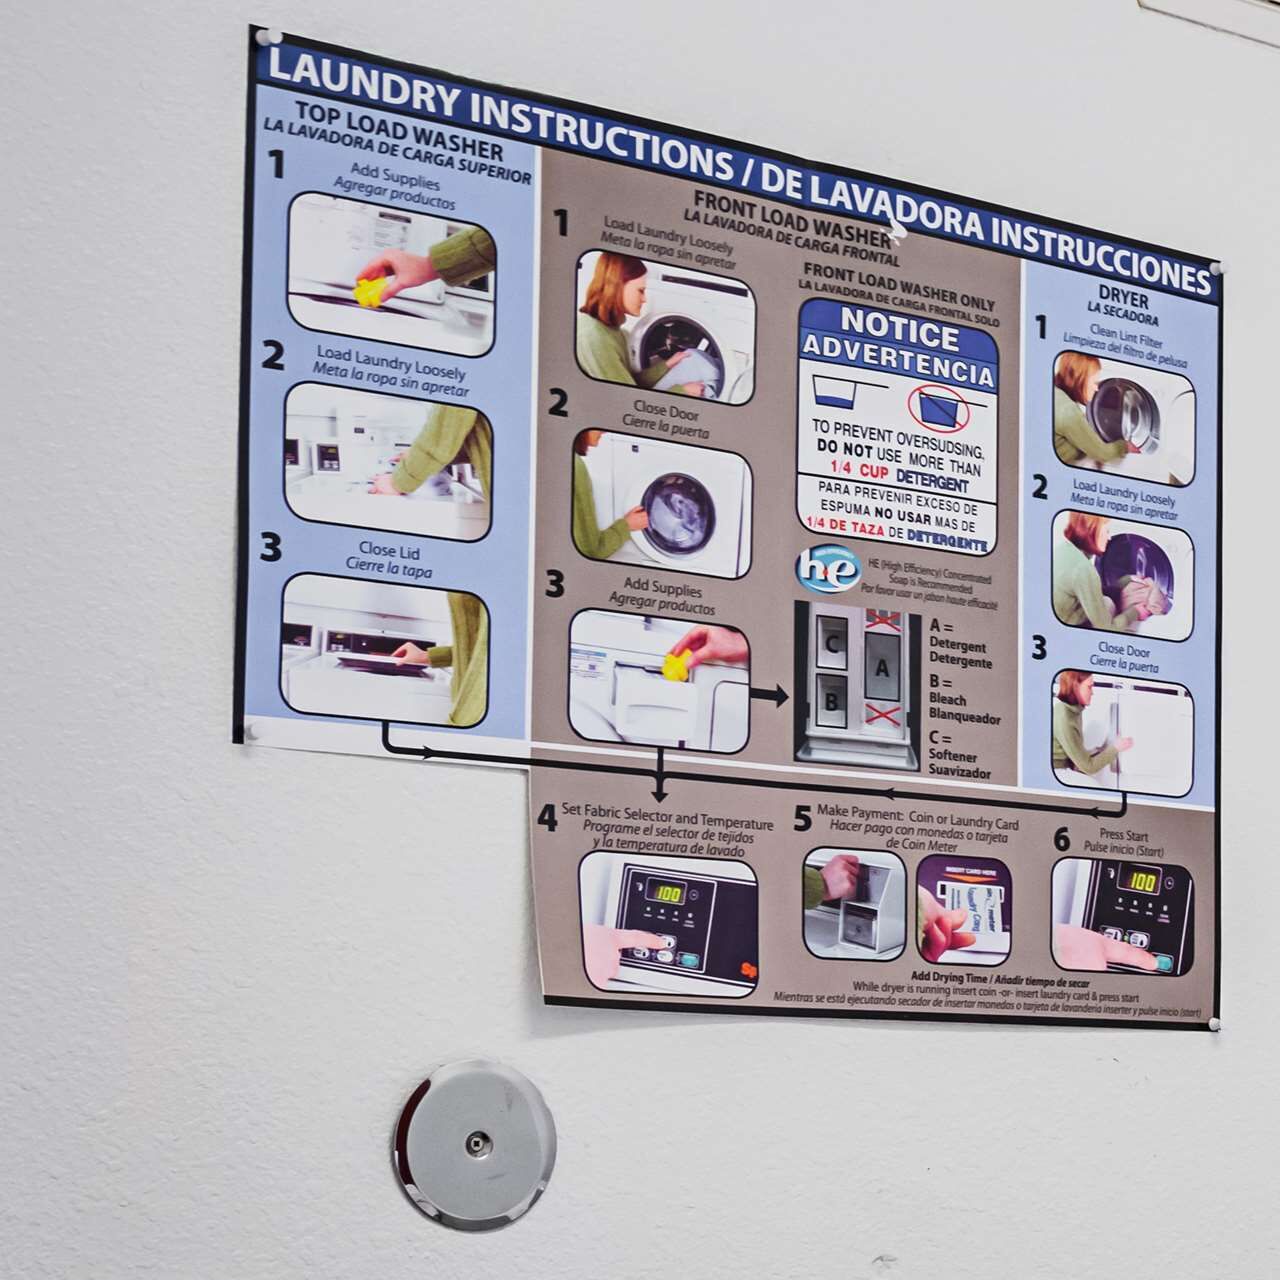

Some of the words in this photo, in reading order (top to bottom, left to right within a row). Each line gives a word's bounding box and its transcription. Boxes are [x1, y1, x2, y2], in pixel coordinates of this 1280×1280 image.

[295, 100, 340, 124] TOP
[347, 112, 407, 139] LOAD
[412, 126, 502, 161] WASHER
[264, 117, 283, 132] LA
[288, 122, 373, 151] LAVADORA
[377, 141, 399, 156] DE
[402, 147, 454, 168] CARGA
[458, 159, 531, 184] SUPERIOR
[269, 149, 283, 178] 1
[270, 47, 459, 115] LAUNDRY
[471, 94, 733, 180] INSTRUCTIONS
[762, 163, 801, 198] DE
[811, 175, 984, 240] LAVADORA
[992, 218, 1210, 295] INSTRUCCIONES
[350, 162, 378, 178] Add
[383, 168, 440, 192] Supplies
[333, 176, 388, 196] Agregar
[390, 190, 455, 210] productos
[554, 209, 568, 236] 1
[694, 190, 756, 218] FRONT
[761, 206, 808, 231] LOAD
[813, 219, 890, 249] WASHER
[604, 216, 634, 232] Load
[637, 223, 687, 246] Laundry
[689, 235, 733, 256] Loosely
[804, 262, 854, 281] FRONT
[858, 272, 897, 290] LOAD
[900, 281, 957, 303] WASHER
[960, 294, 994, 311] ONLY
[1099, 284, 1148, 309] DRYER
[1035, 314, 1046, 339] 1
[1088, 301, 1100, 312] LA
[1103, 304, 1158, 326] SECADORA
[842, 307, 958, 351] NOTICE
[261, 340, 284, 371] 2
[317, 345, 351, 361] Load
[356, 351, 412, 374] Laundry
[416, 361, 465, 382] Loosely
[803, 335, 993, 386] ADVERTENCIA
[313, 361, 348, 377] Meta
[351, 367, 363, 380] la
[366, 373, 397, 386] ropa
[400, 377, 418, 388] sin
[421, 382, 469, 396] apretar
[548, 388, 568, 417] 2
[633, 400, 666, 416] Close
[669, 406, 698, 420] Door
[622, 413, 656, 429] Cierre
[658, 420, 669, 431] la
[671, 425, 709, 439] puerta
[812, 418, 829, 433] TO
[834, 422, 892, 441] PREVENT
[896, 432, 984, 459] OVERSUDSING.
[817, 438, 837, 452] DO
[844, 442, 872, 457] NOT
[877, 448, 901, 462] USE
[909, 452, 943, 470] MORE
[950, 459, 980, 476] THAN
[831, 460, 850, 473] 1/4
[860, 464, 888, 478] CUP
[896, 469, 969, 492] DETERGENT
[1032, 474, 1048, 500] 2
[819, 481, 850, 494] PARA
[854, 486, 911, 503] PREVENIR
[916, 495, 959, 512] EXCESO
[964, 504, 976, 515] DE
[821, 499, 870, 515] ESPUMA
[875, 507, 892, 518] NO
[898, 510, 930, 524] USAR
[935, 516, 957, 529] MAS
[962, 520, 974, 532] DE
[260, 532, 282, 562] 3
[807, 517, 824, 528] 1/4
[830, 519, 846, 530] DE
[852, 522, 884, 535] TAZA
[889, 527, 903, 538] DE
[907, 529, 987, 552] DETERGENTE
[359, 541, 396, 557] Close
[400, 547, 419, 560] Lid
[346, 556, 384, 572] Cierre
[387, 561, 399, 574] la
[402, 565, 432, 579] tapa
[545, 570, 564, 598] 3
[624, 577, 648, 590] Add
[652, 580, 702, 598] Supplies
[608, 591, 656, 608] Agregar
[658, 600, 714, 615] productos
[929, 618, 940, 632] A
[826, 636, 839, 653] C
[930, 636, 986, 653] Detergent
[1032, 634, 1047, 660] 3
[875, 660, 890, 677] A
[930, 651, 992, 669] Detergente
[929, 674, 939, 688] B
[825, 693, 839, 711] B
[930, 692, 966, 706] Bleach
[929, 707, 1001, 724] Blanqueador
[929, 730, 939, 744] C
[929, 748, 977, 762] Softener
[929, 763, 991, 778] Suavizador
[538, 804, 558, 832] 4
[562, 802, 581, 815] Set
[584, 804, 620, 818] Fabric
[624, 807, 672, 822] Selector
[675, 813, 697, 824] and
[700, 814, 773, 832] Temperature
[794, 804, 812, 832] 5
[817, 804, 848, 816] Make
[852, 806, 903, 820] Payment:
[909, 811, 933, 822] Coin
[936, 816, 947, 824] or
[950, 814, 993, 830] Laundry
[995, 818, 1018, 830] Card
[583, 819, 640, 836] Programe
[642, 824, 653, 835] el
[655, 826, 699, 838] selector
[701, 829, 715, 840] de
[718, 828, 753, 846] tejidos
[1054, 826, 1070, 851] 6
[1100, 828, 1124, 839] Press
[1126, 830, 1148, 842] Start
[656, 885, 681, 902] 100
[1130, 872, 1156, 892] 100
